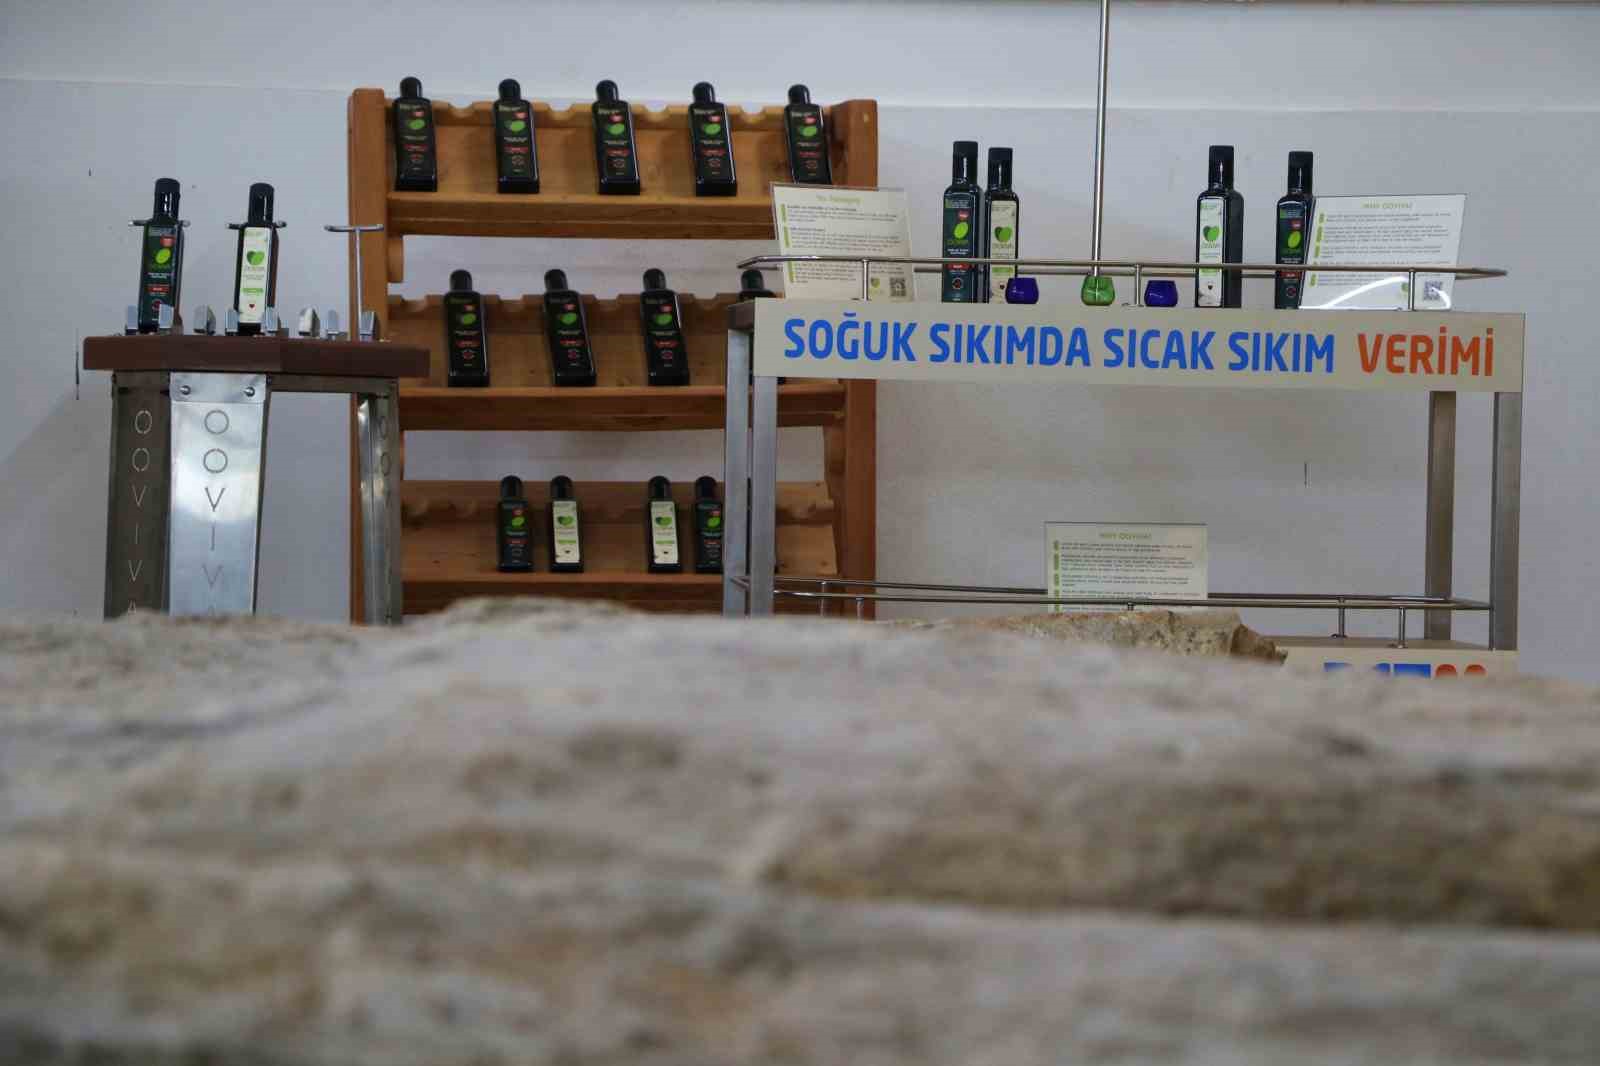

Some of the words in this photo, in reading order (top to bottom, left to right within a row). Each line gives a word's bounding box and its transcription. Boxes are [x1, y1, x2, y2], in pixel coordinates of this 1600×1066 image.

[783, 312, 917, 361] SOĞUK
[929, 322, 1091, 367] SIKIMDA
[1103, 328, 1215, 370] SICAK
[1228, 331, 1335, 373] SIKIM
[1358, 326, 1494, 376] VERİMİ
